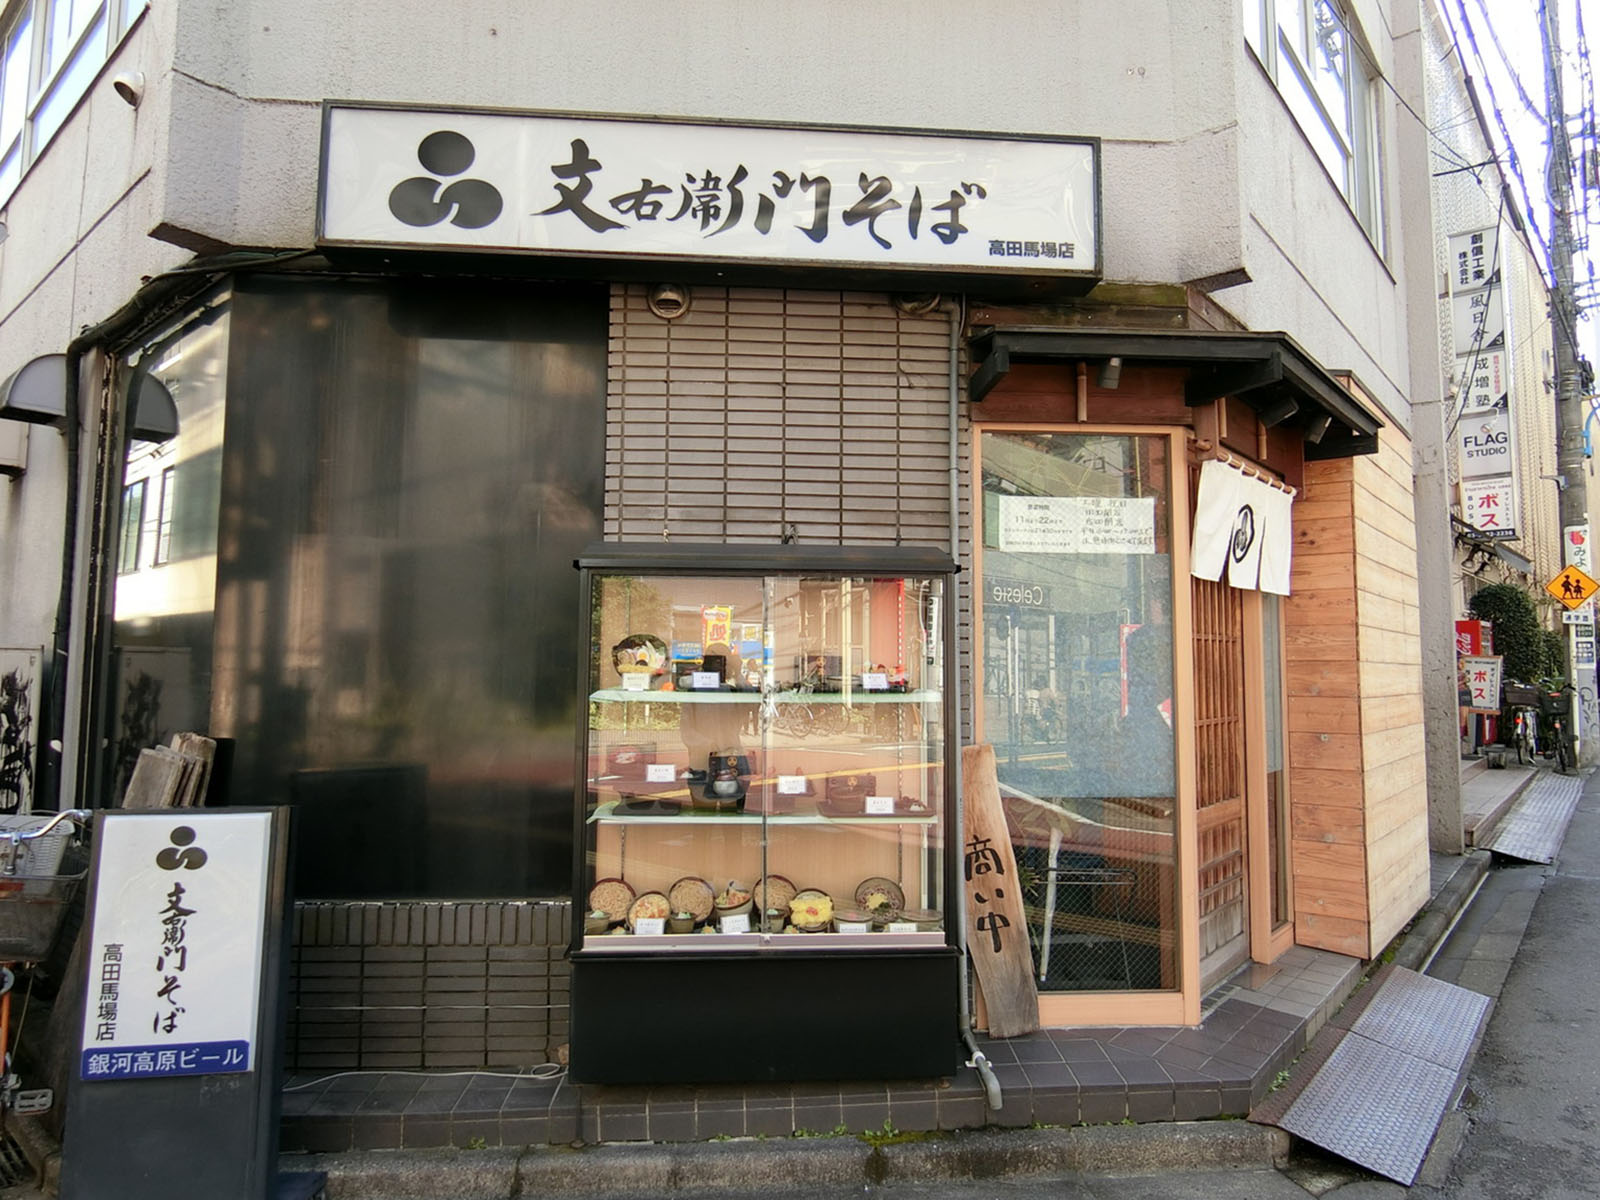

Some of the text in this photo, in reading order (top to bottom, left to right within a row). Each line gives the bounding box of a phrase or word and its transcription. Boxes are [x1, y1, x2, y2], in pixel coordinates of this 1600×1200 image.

[988, 239, 1075, 259] 高田馬場店
[1458, 251, 1469, 285] 株式会社
[1496, 336, 1503, 344] 3
[1497, 399, 1504, 408] 2
[1464, 432, 1508, 448] FLAG
[1467, 446, 1507, 458] STUDIO
[1479, 493, 1499, 528] ボス
[1473, 670, 1487, 700] ボス
[964, 834, 1010, 953] 商い中
[95, 943, 124, 1042] 高田馬場店
[88, 1047, 245, 1075] 銀河高原ビール
